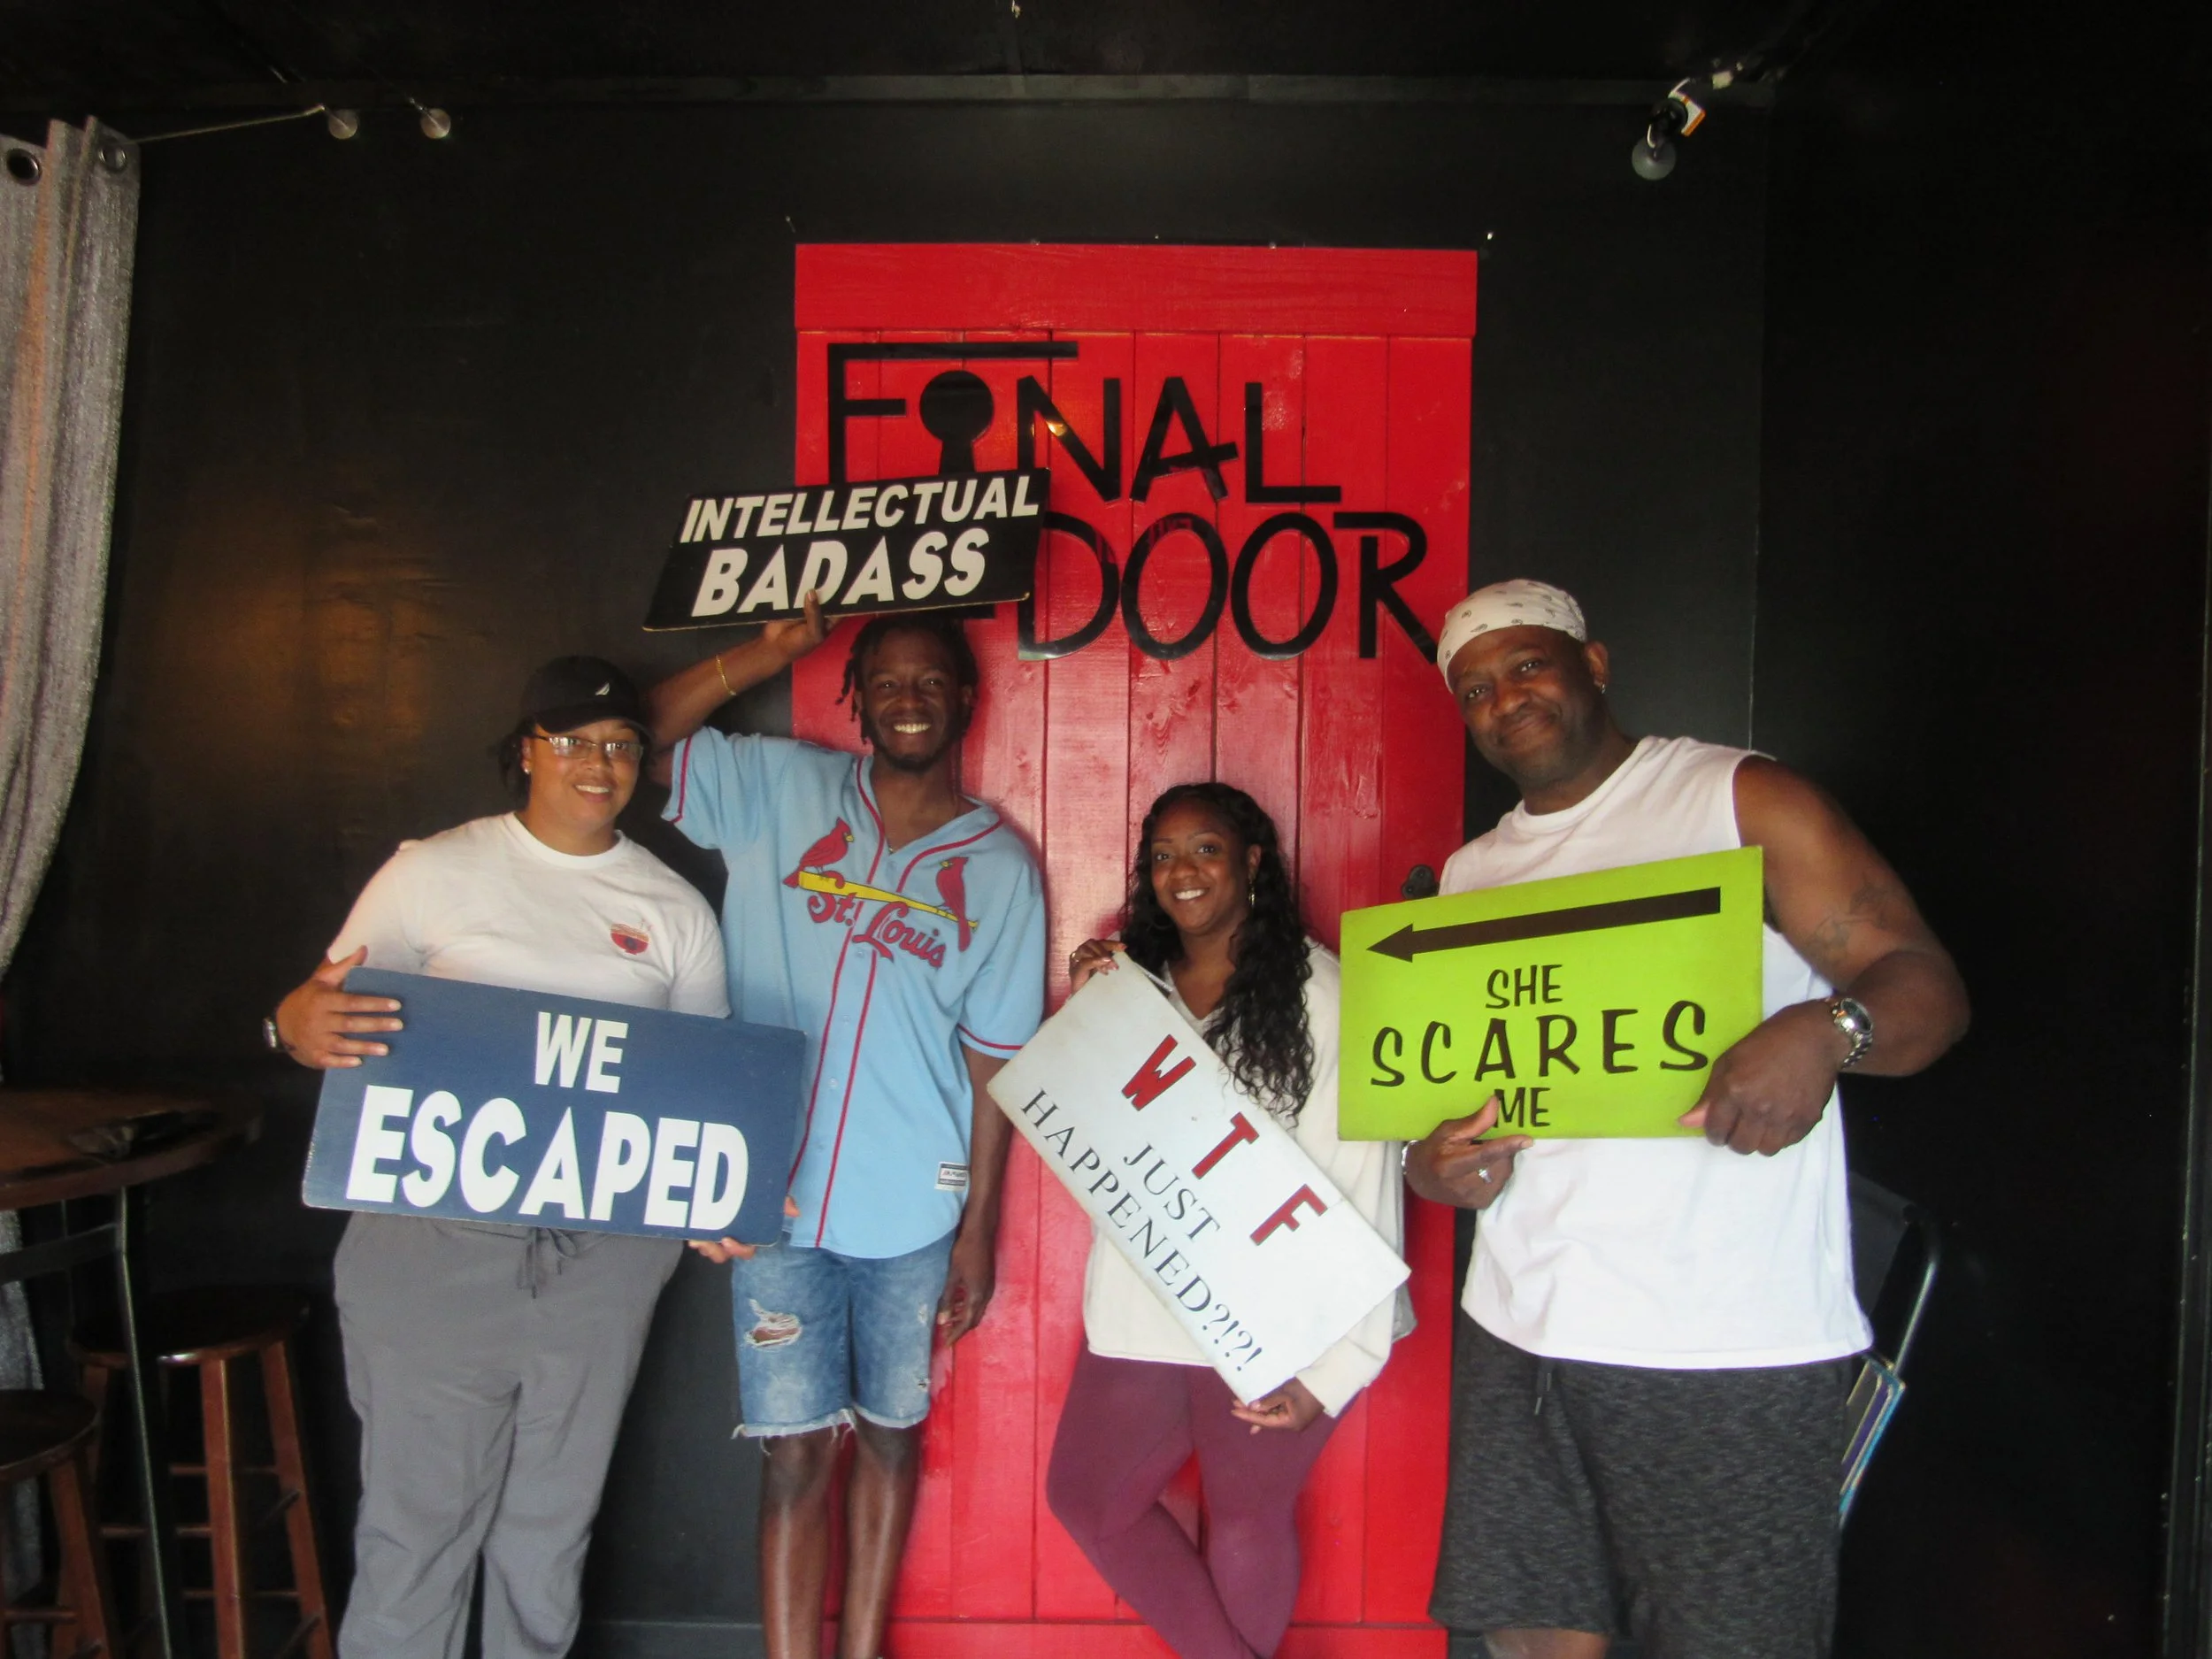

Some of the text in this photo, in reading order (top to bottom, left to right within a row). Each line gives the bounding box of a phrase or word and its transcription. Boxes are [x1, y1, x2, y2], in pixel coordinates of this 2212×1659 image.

[680, 475, 1040, 544] INTELLECTUAL
[691, 527, 990, 618] BADASS
[1018, 511, 1439, 666] DOOR
[807, 870, 947, 970] St. Louis
[1485, 964, 1563, 1010] SHE
[534, 1010, 629, 1094] WE
[1371, 1000, 1709, 1088] SCARES
[1493, 1087, 1551, 1129] ME
[345, 1084, 749, 1231] ESCAPED
[1123, 1143, 1221, 1244] JUST
[1021, 1087, 1263, 1372] HAPPENED?!?!
